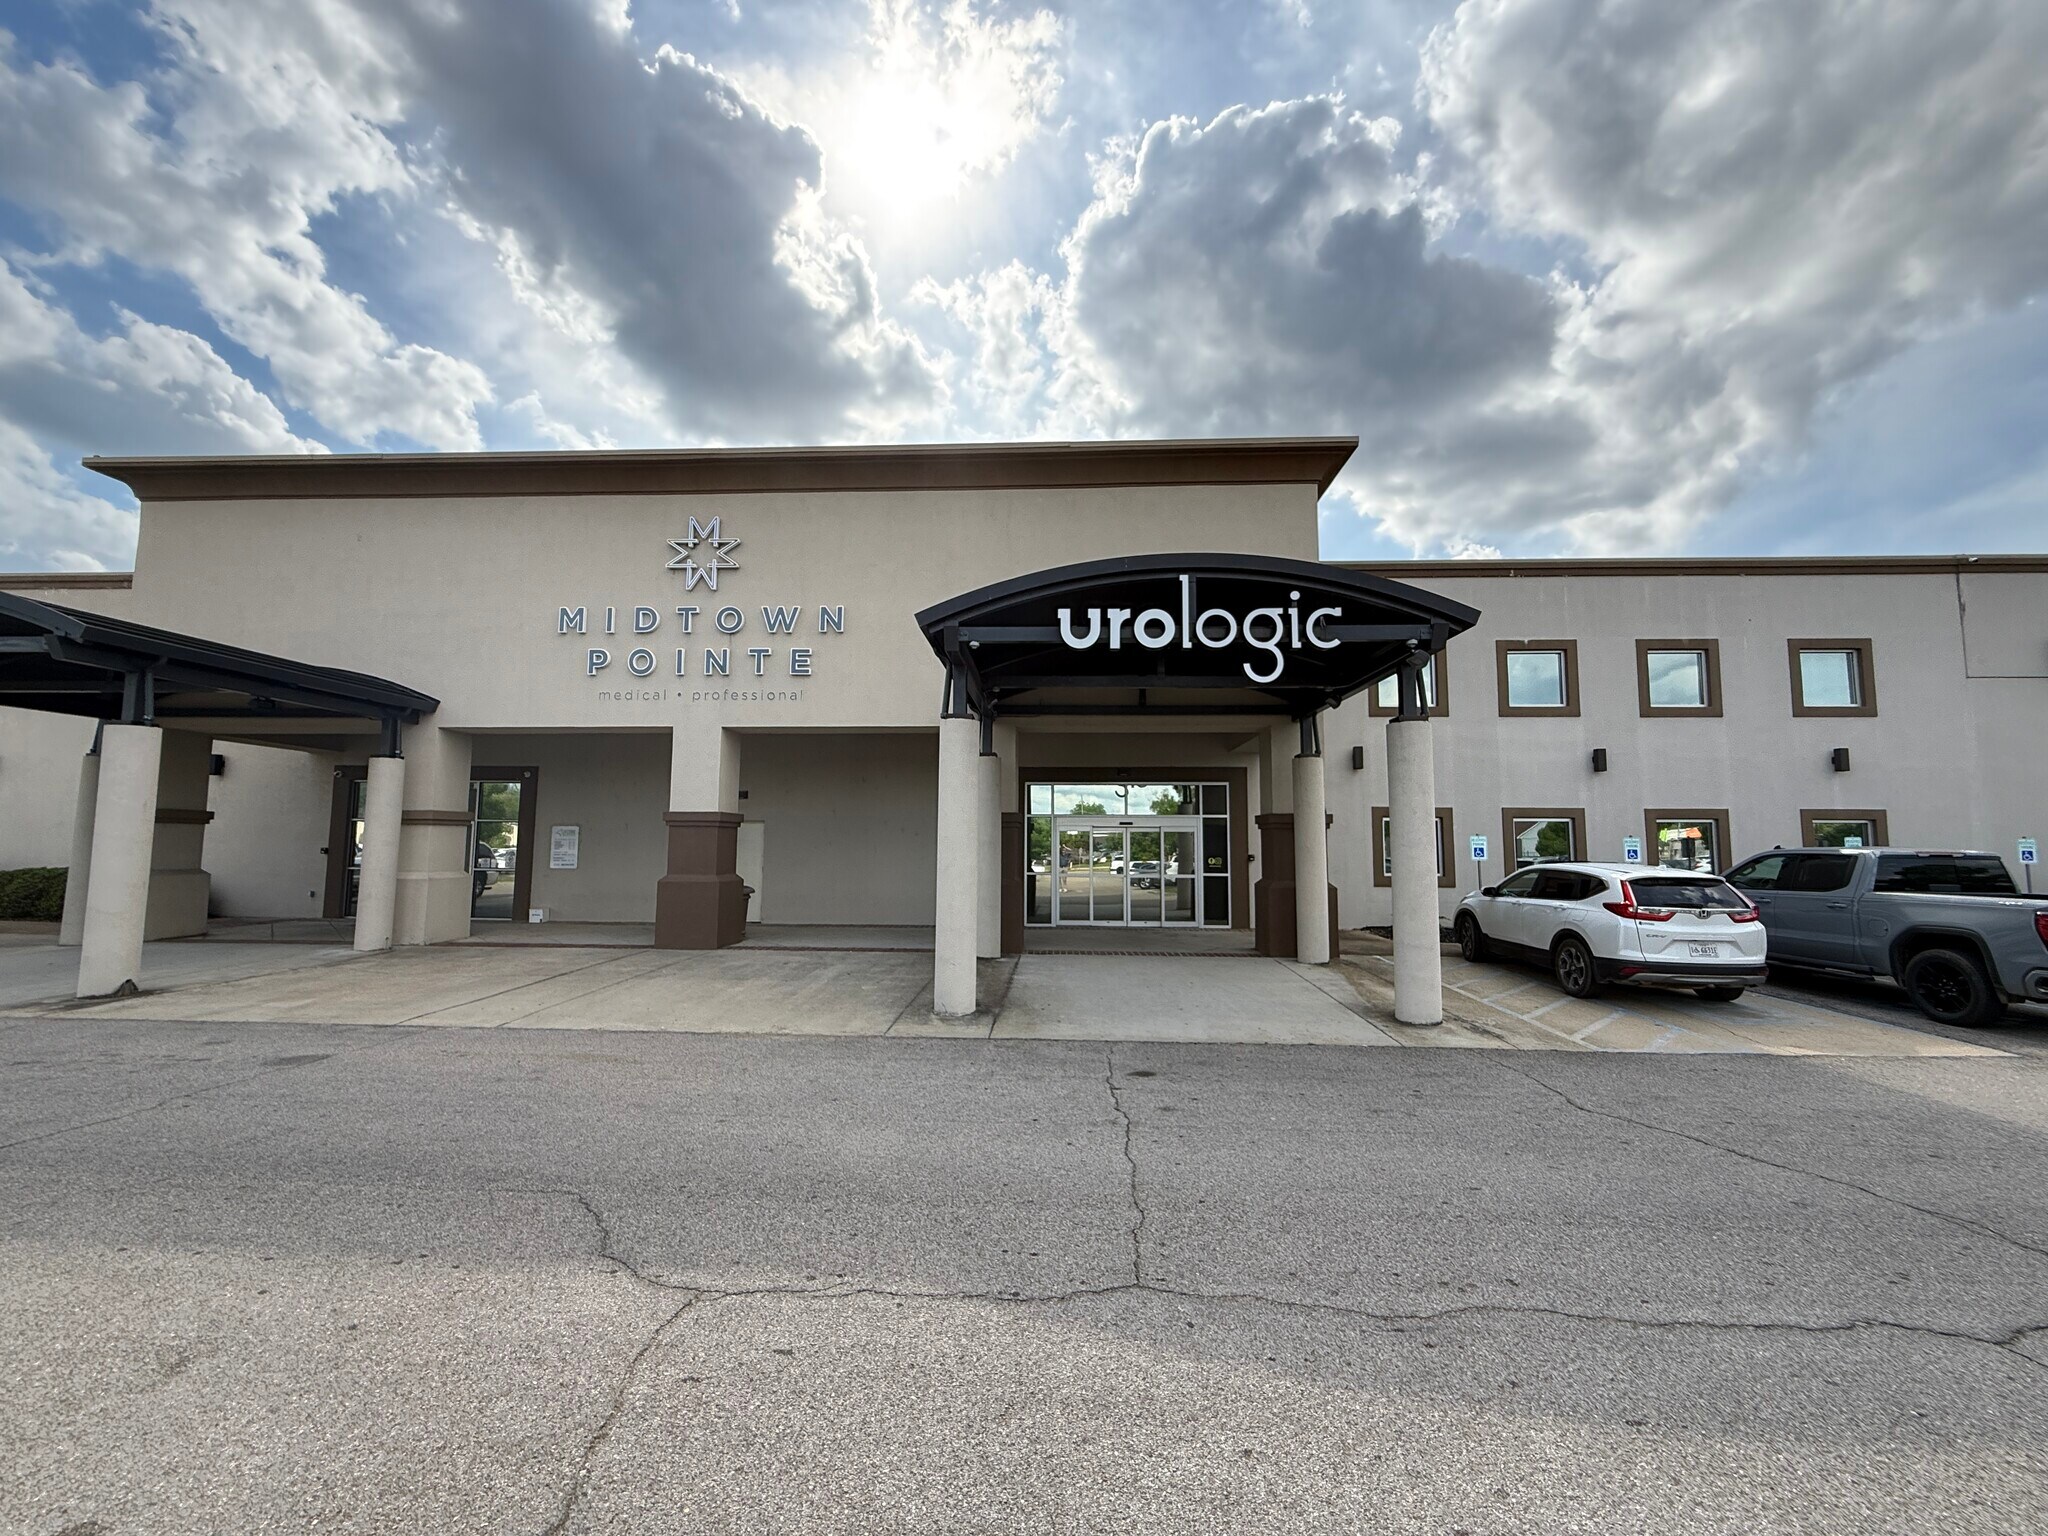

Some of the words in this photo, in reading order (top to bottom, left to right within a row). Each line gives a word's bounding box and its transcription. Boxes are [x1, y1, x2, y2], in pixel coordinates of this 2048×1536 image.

[557, 605, 845, 634] MIDTOWN
[1057, 574, 1343, 684] urologic
[586, 647, 813, 677] POINTE
[598, 688, 667, 701] medical
[691, 688, 804, 702] professional
